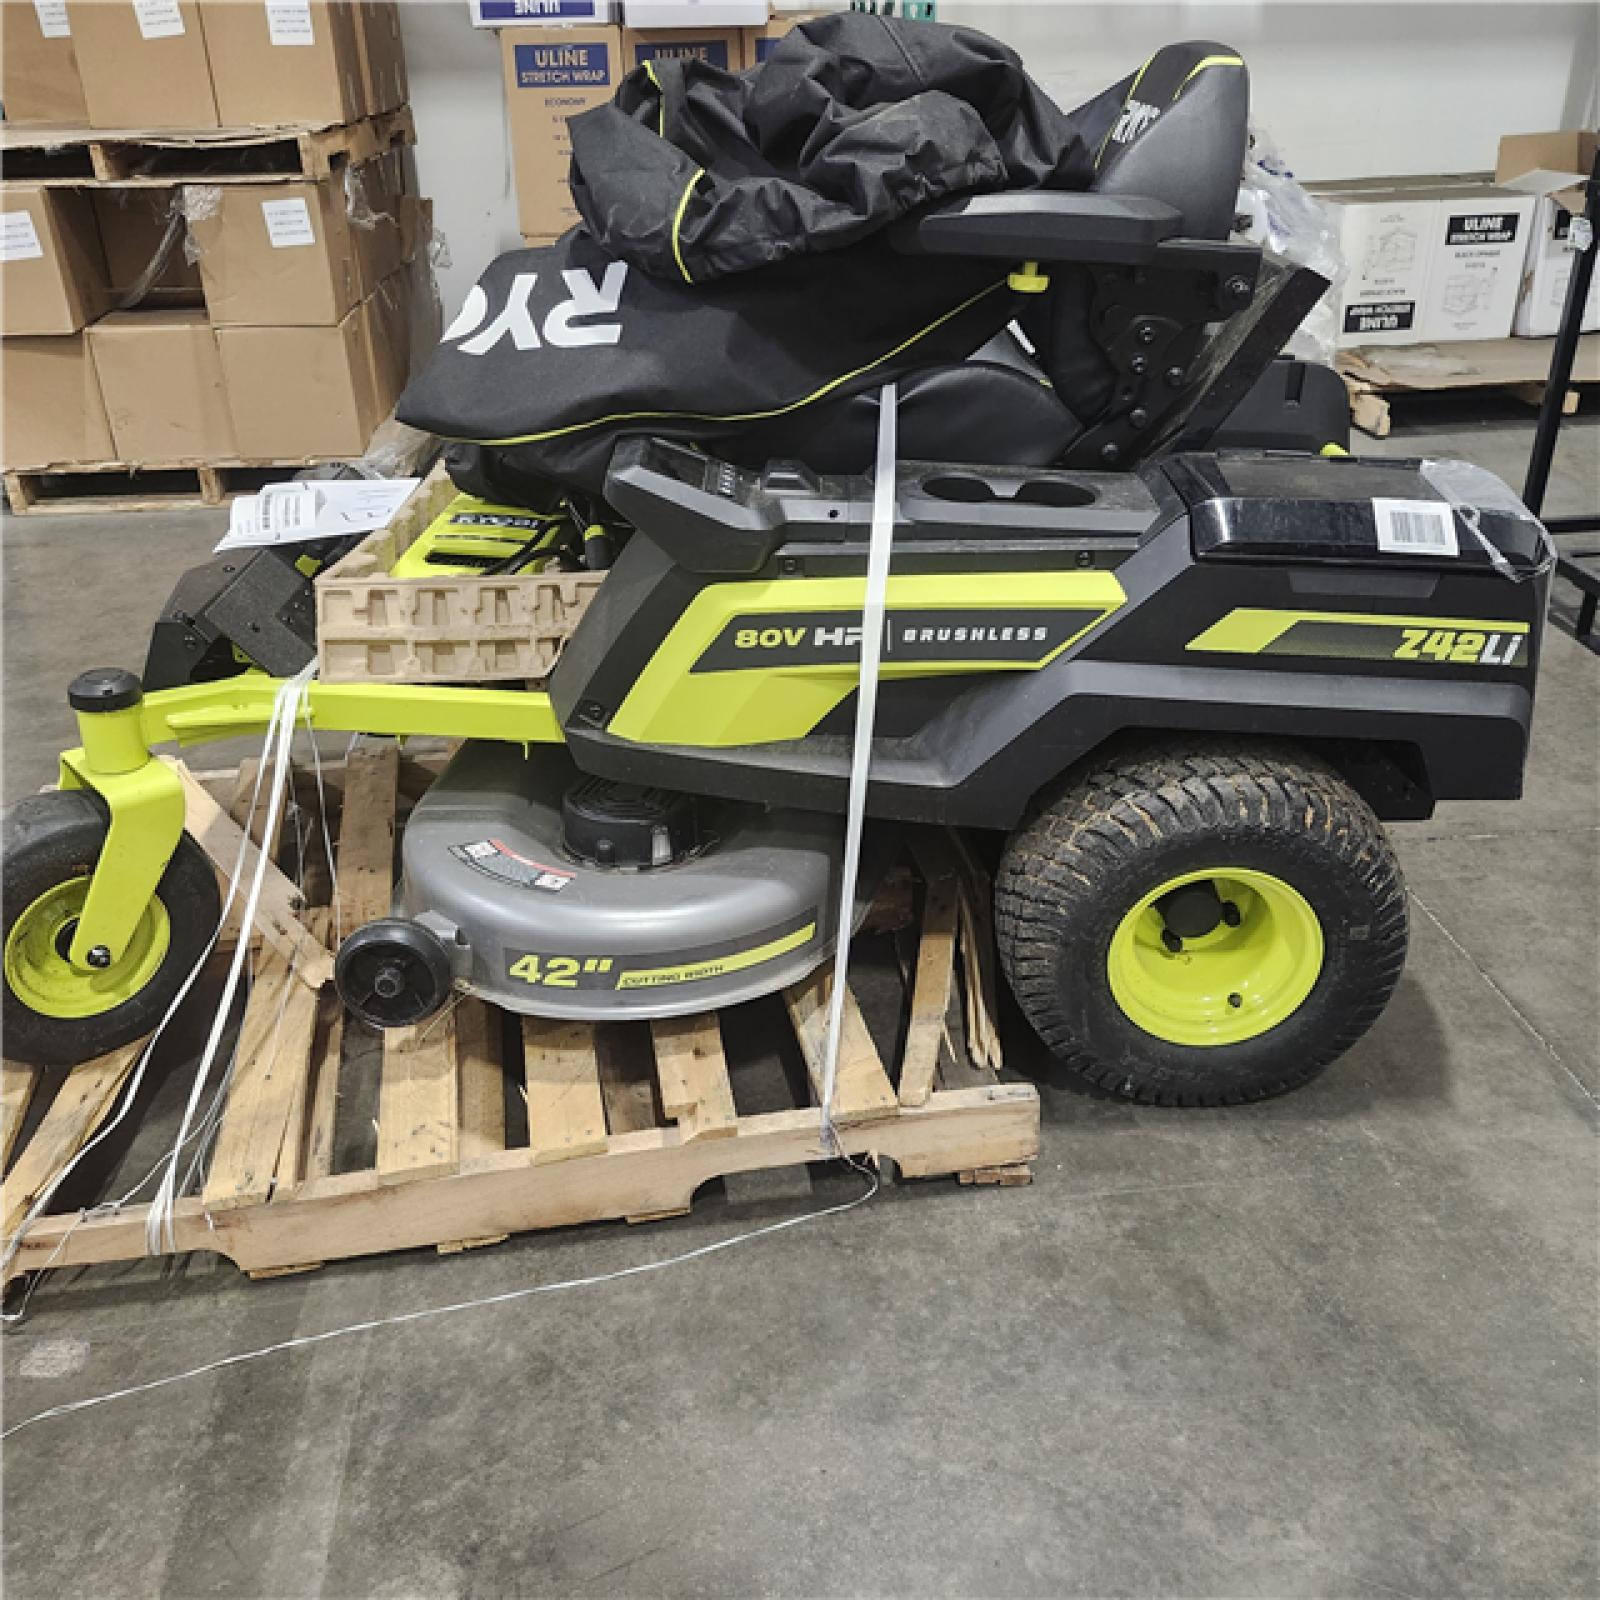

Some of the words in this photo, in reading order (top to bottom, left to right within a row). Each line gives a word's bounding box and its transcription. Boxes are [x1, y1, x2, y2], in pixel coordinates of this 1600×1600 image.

[534, 49, 588, 67] ULINE
[521, 72, 569, 84] STRETCH
[574, 70, 606, 83] WRAP
[735, 628, 807, 648] 80V
[903, 627, 1049, 642] BRUSHLESS
[508, 953, 613, 988] 42"
